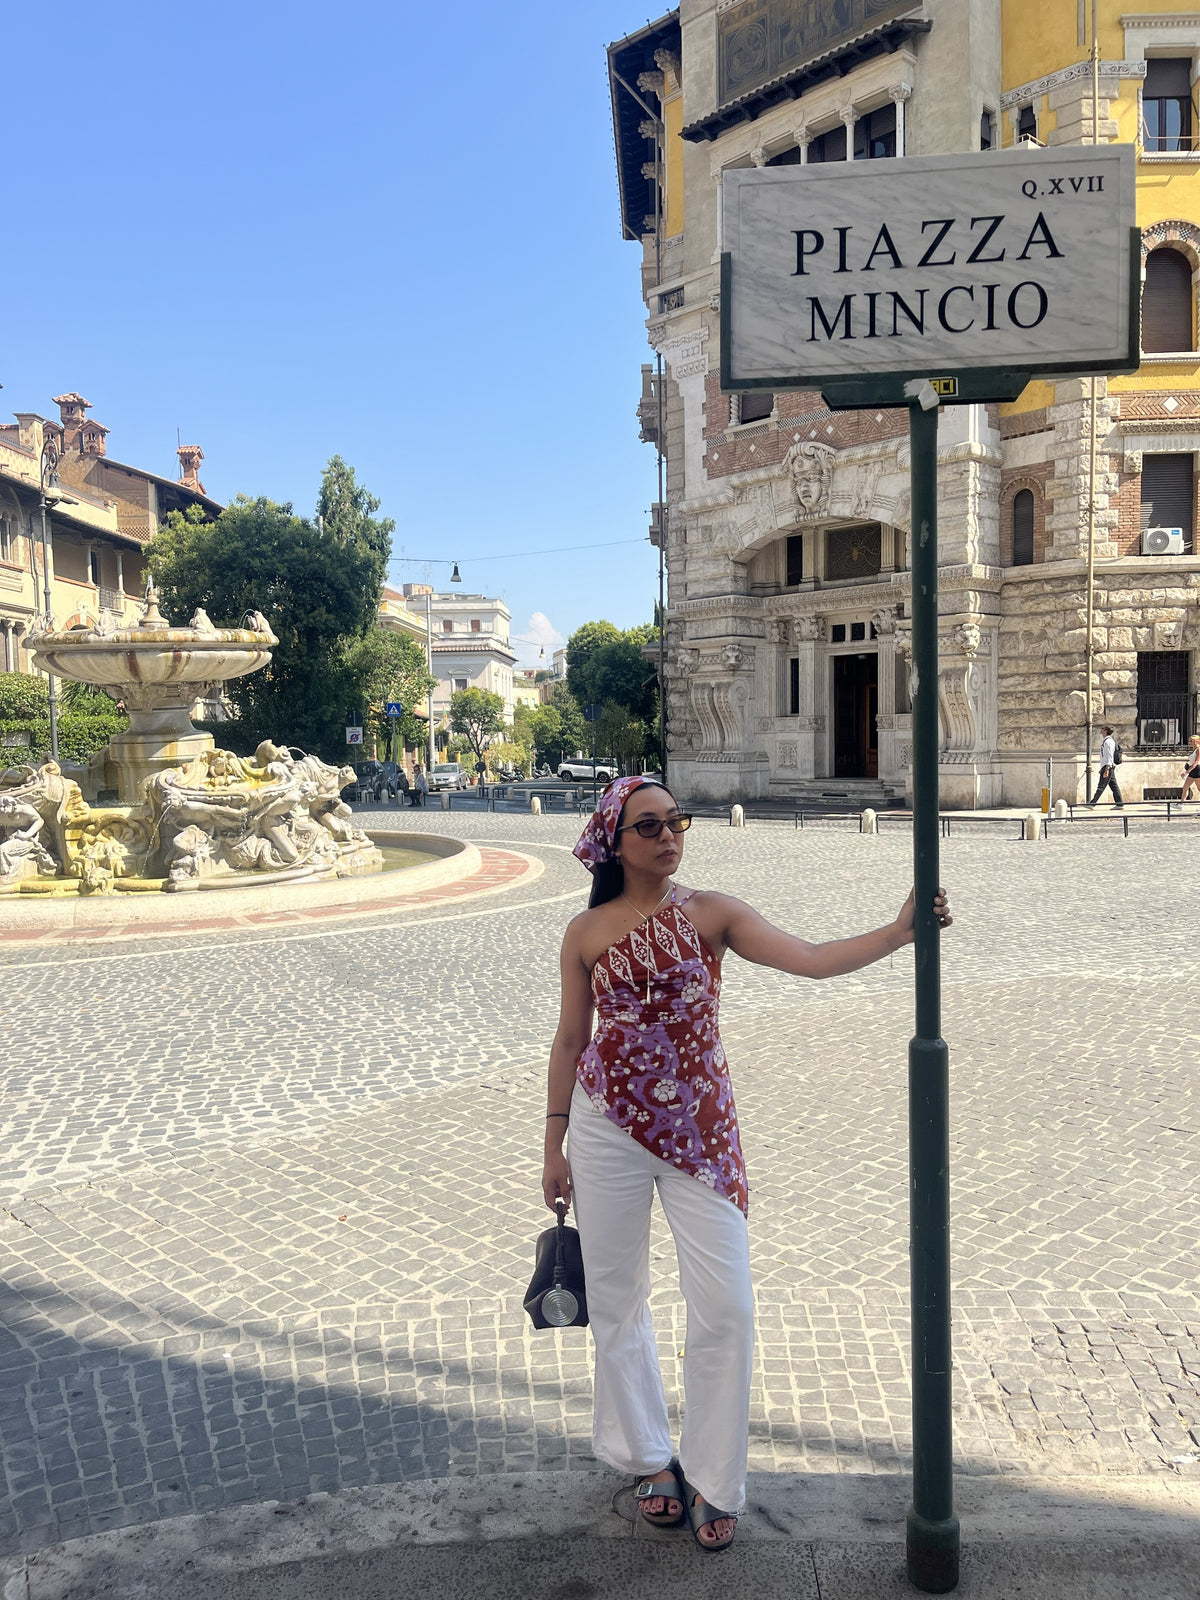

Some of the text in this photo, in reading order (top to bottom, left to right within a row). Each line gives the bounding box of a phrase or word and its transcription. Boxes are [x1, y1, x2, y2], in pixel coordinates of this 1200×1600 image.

[1022, 175, 1104, 200] Q.XVII
[790, 211, 1065, 276] PIAZZA
[805, 281, 1049, 342] MINCIO
